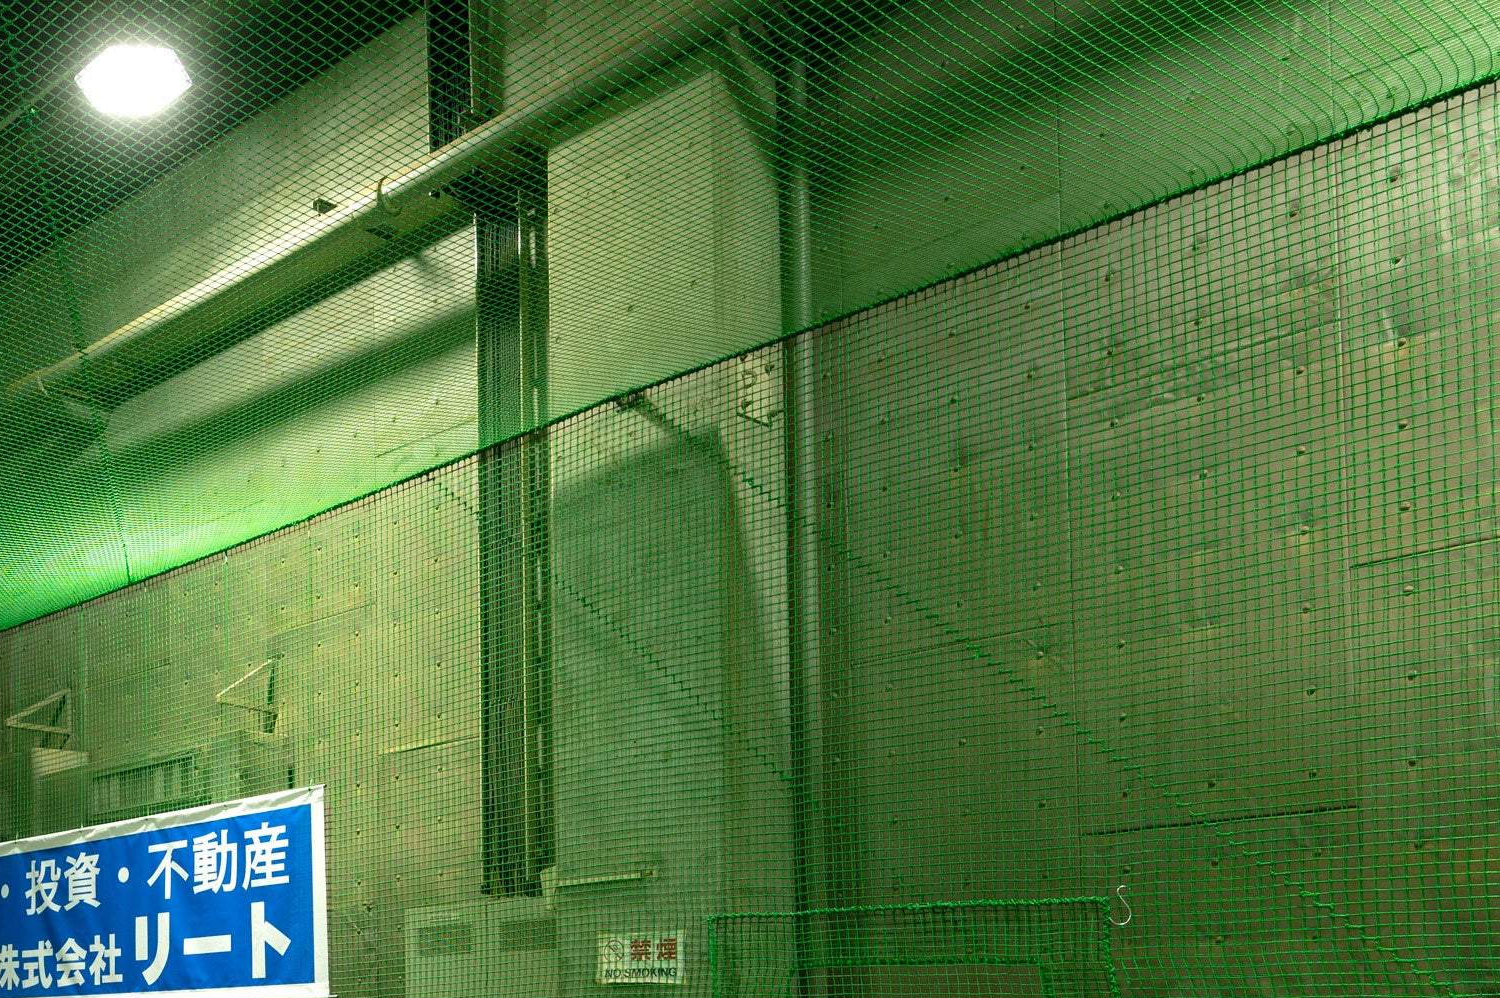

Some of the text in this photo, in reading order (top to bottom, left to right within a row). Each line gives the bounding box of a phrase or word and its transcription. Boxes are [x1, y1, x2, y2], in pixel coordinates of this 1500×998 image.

[631, 938, 676, 961] 禁煙
[604, 966, 678, 978] NO SMOKING
